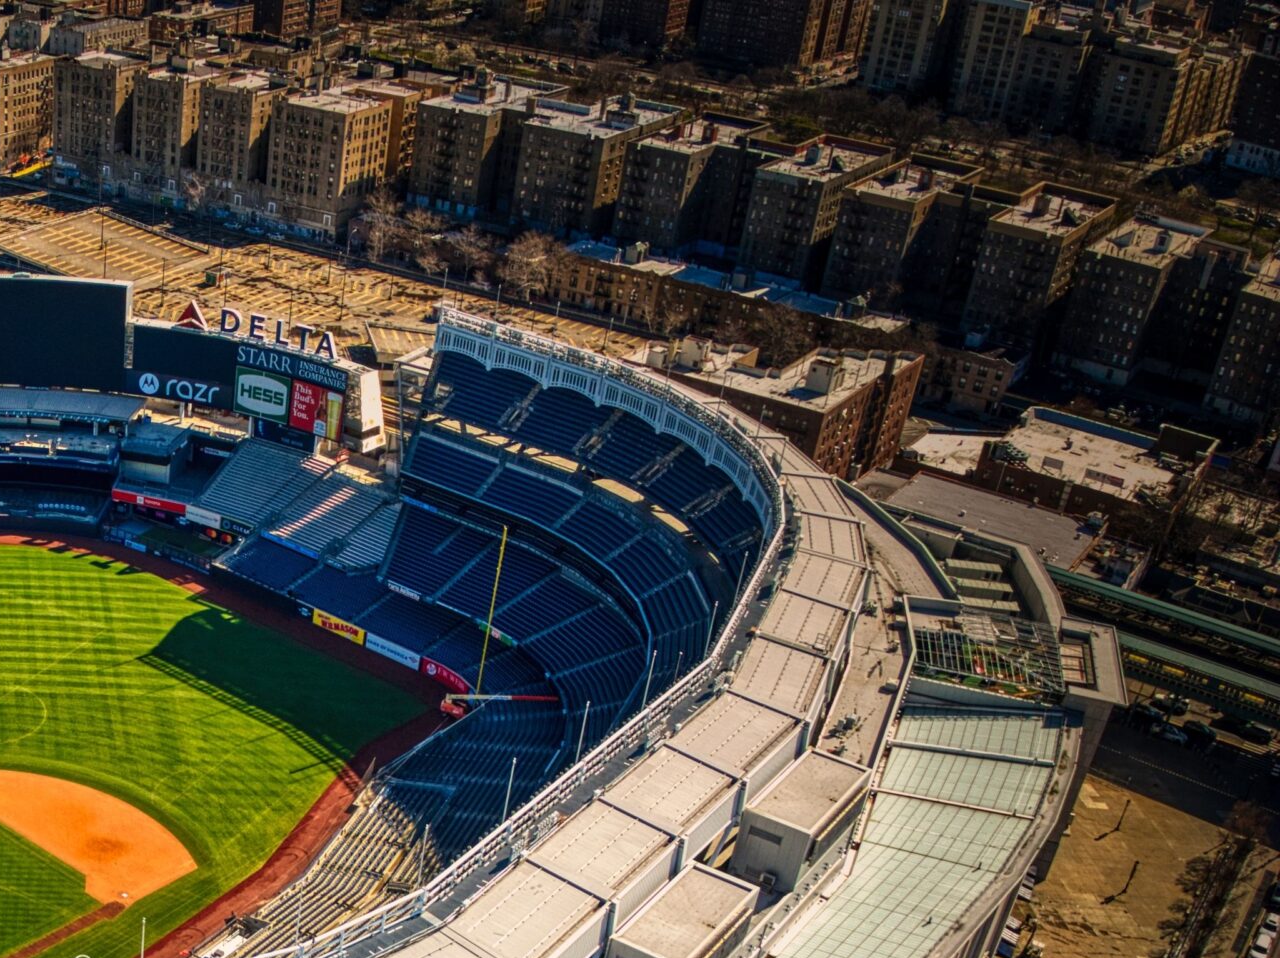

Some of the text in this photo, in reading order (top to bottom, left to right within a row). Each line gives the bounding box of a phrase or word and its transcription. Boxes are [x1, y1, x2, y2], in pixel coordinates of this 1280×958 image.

[220, 307, 338, 360] DELTA
[236, 346, 293, 374] STARR
[298, 369, 347, 391] COMPANIES
[299, 361, 347, 381] INSURANCE
[165, 378, 220, 404] razr
[239, 384, 285, 407] HESS
[294, 391, 316, 405] Bud's
[295, 383, 313, 395] This
[292, 407, 310, 421] You.
[293, 400, 307, 411] For
